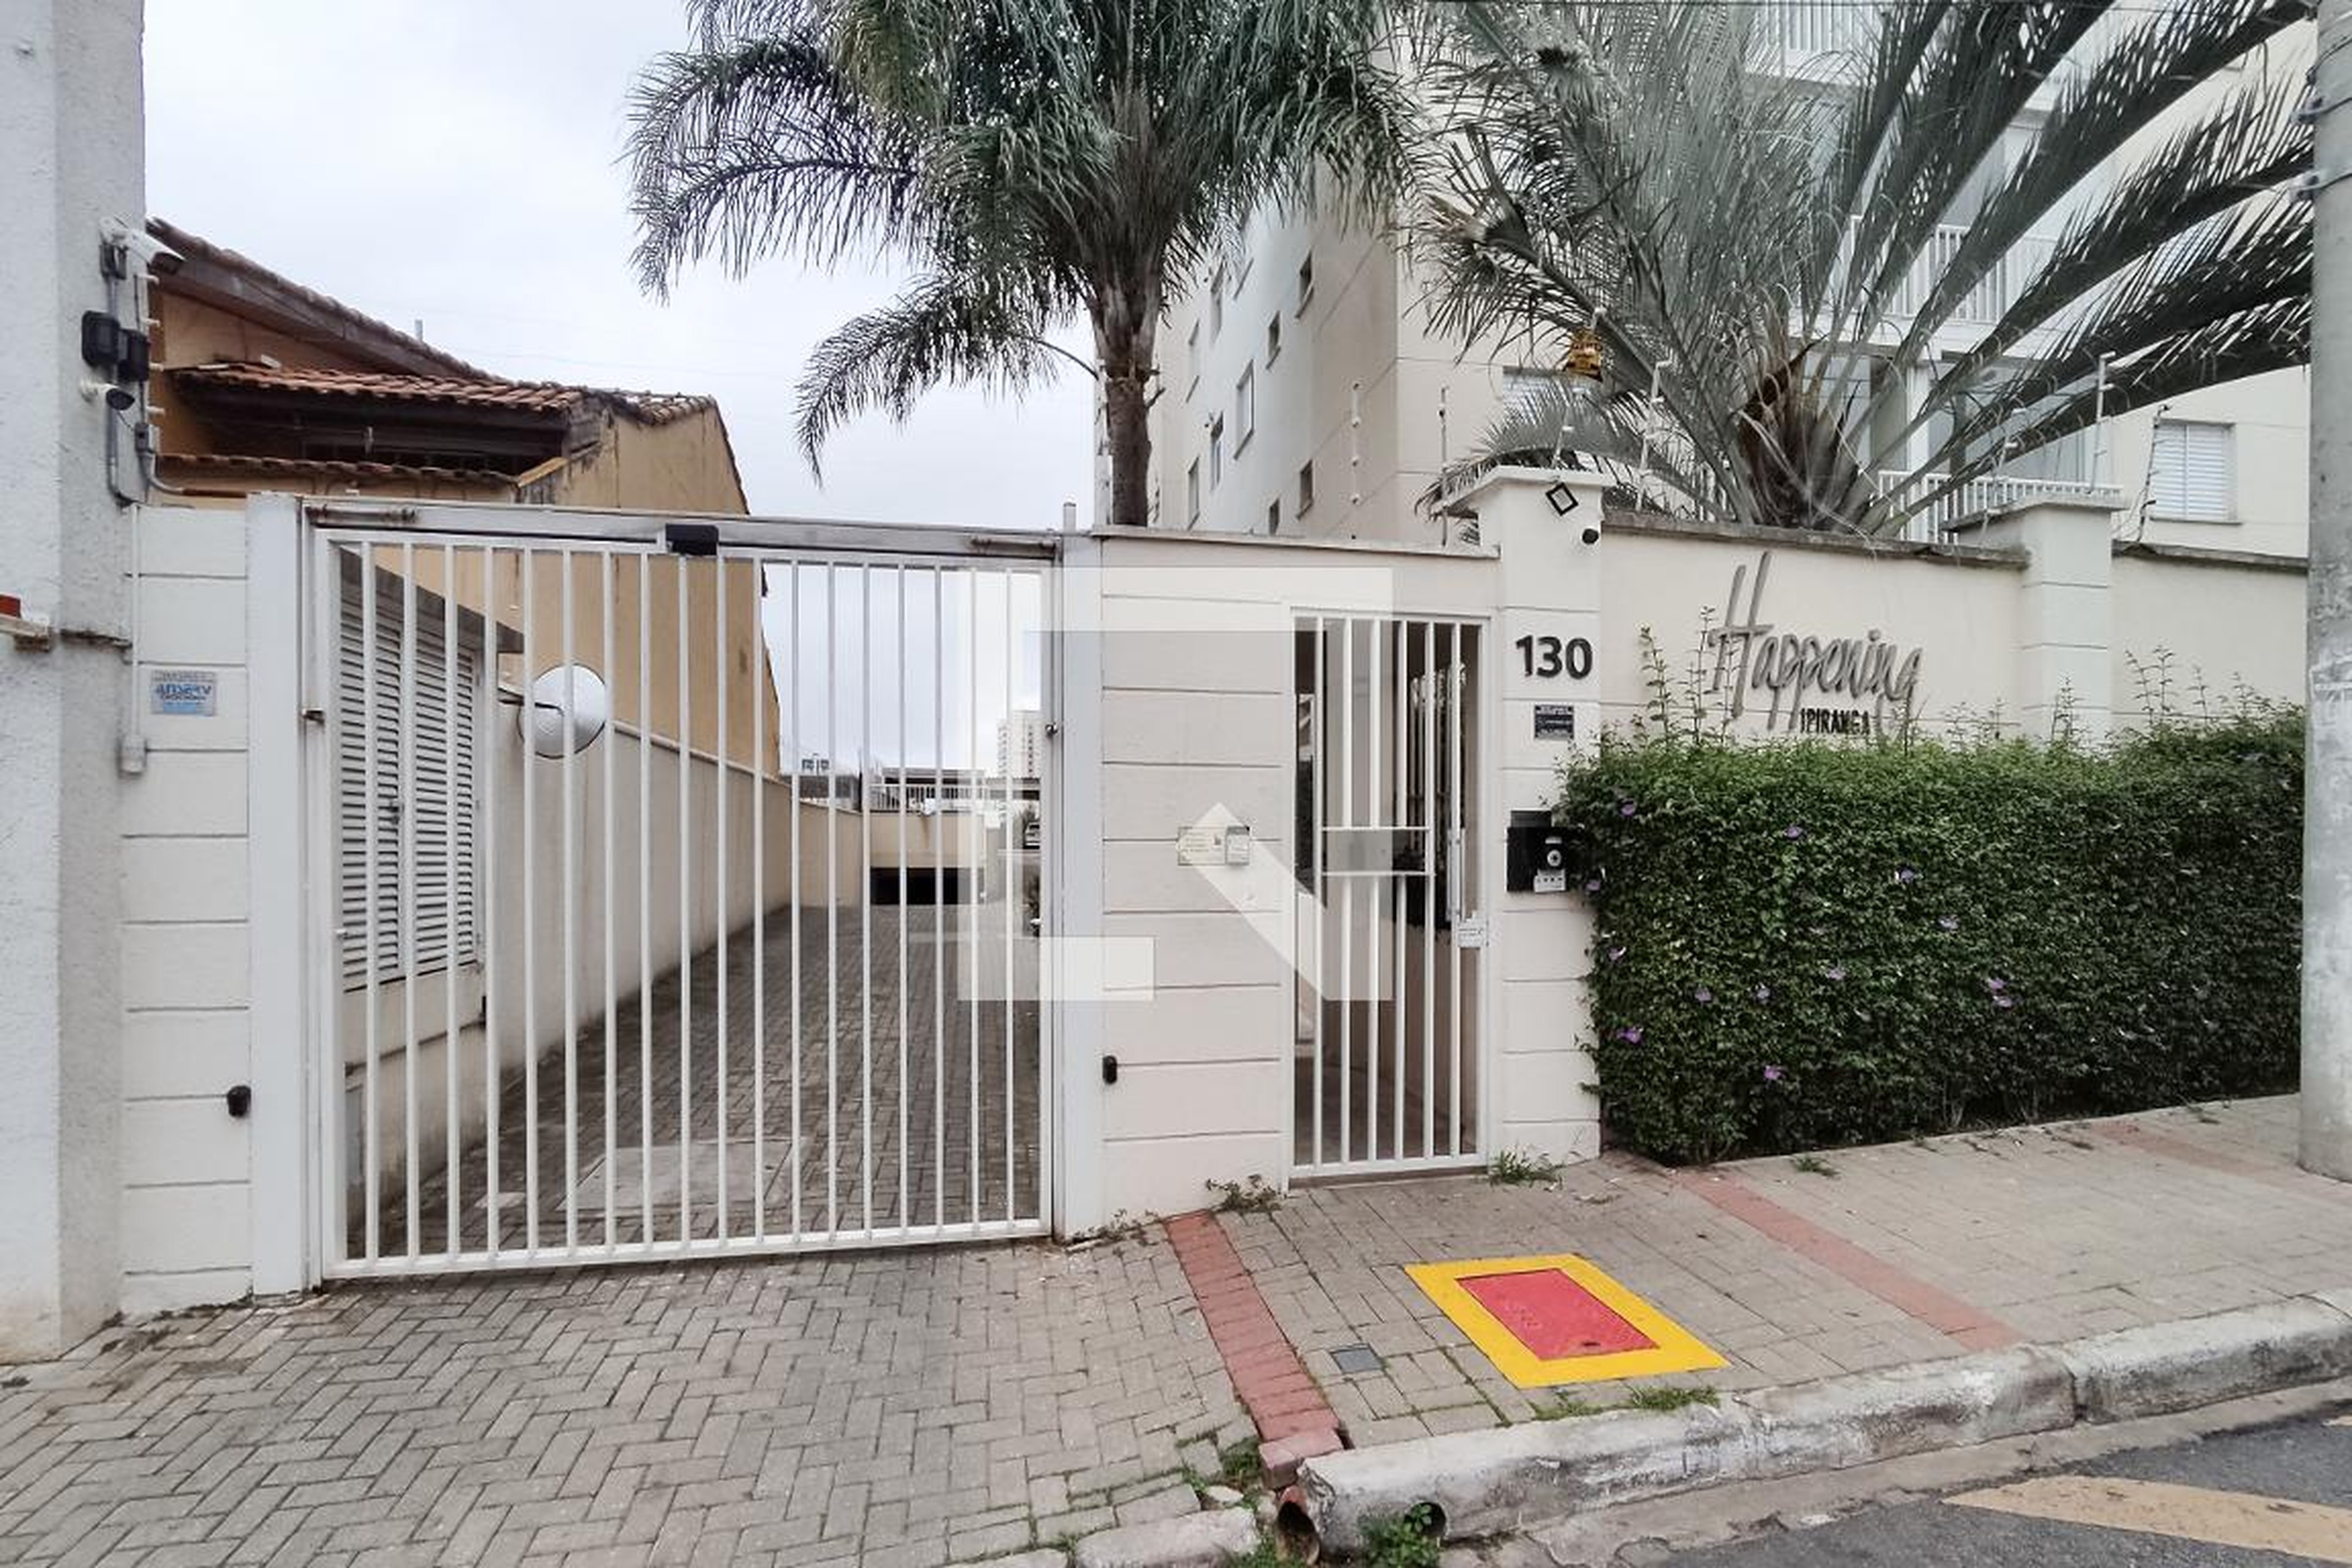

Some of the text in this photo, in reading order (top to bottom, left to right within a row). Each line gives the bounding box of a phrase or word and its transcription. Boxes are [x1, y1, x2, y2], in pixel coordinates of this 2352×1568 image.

[1515, 635, 1593, 679] 130
[1707, 551, 1923, 737] Happening
[1801, 707, 1870, 735] IPIRANGA
